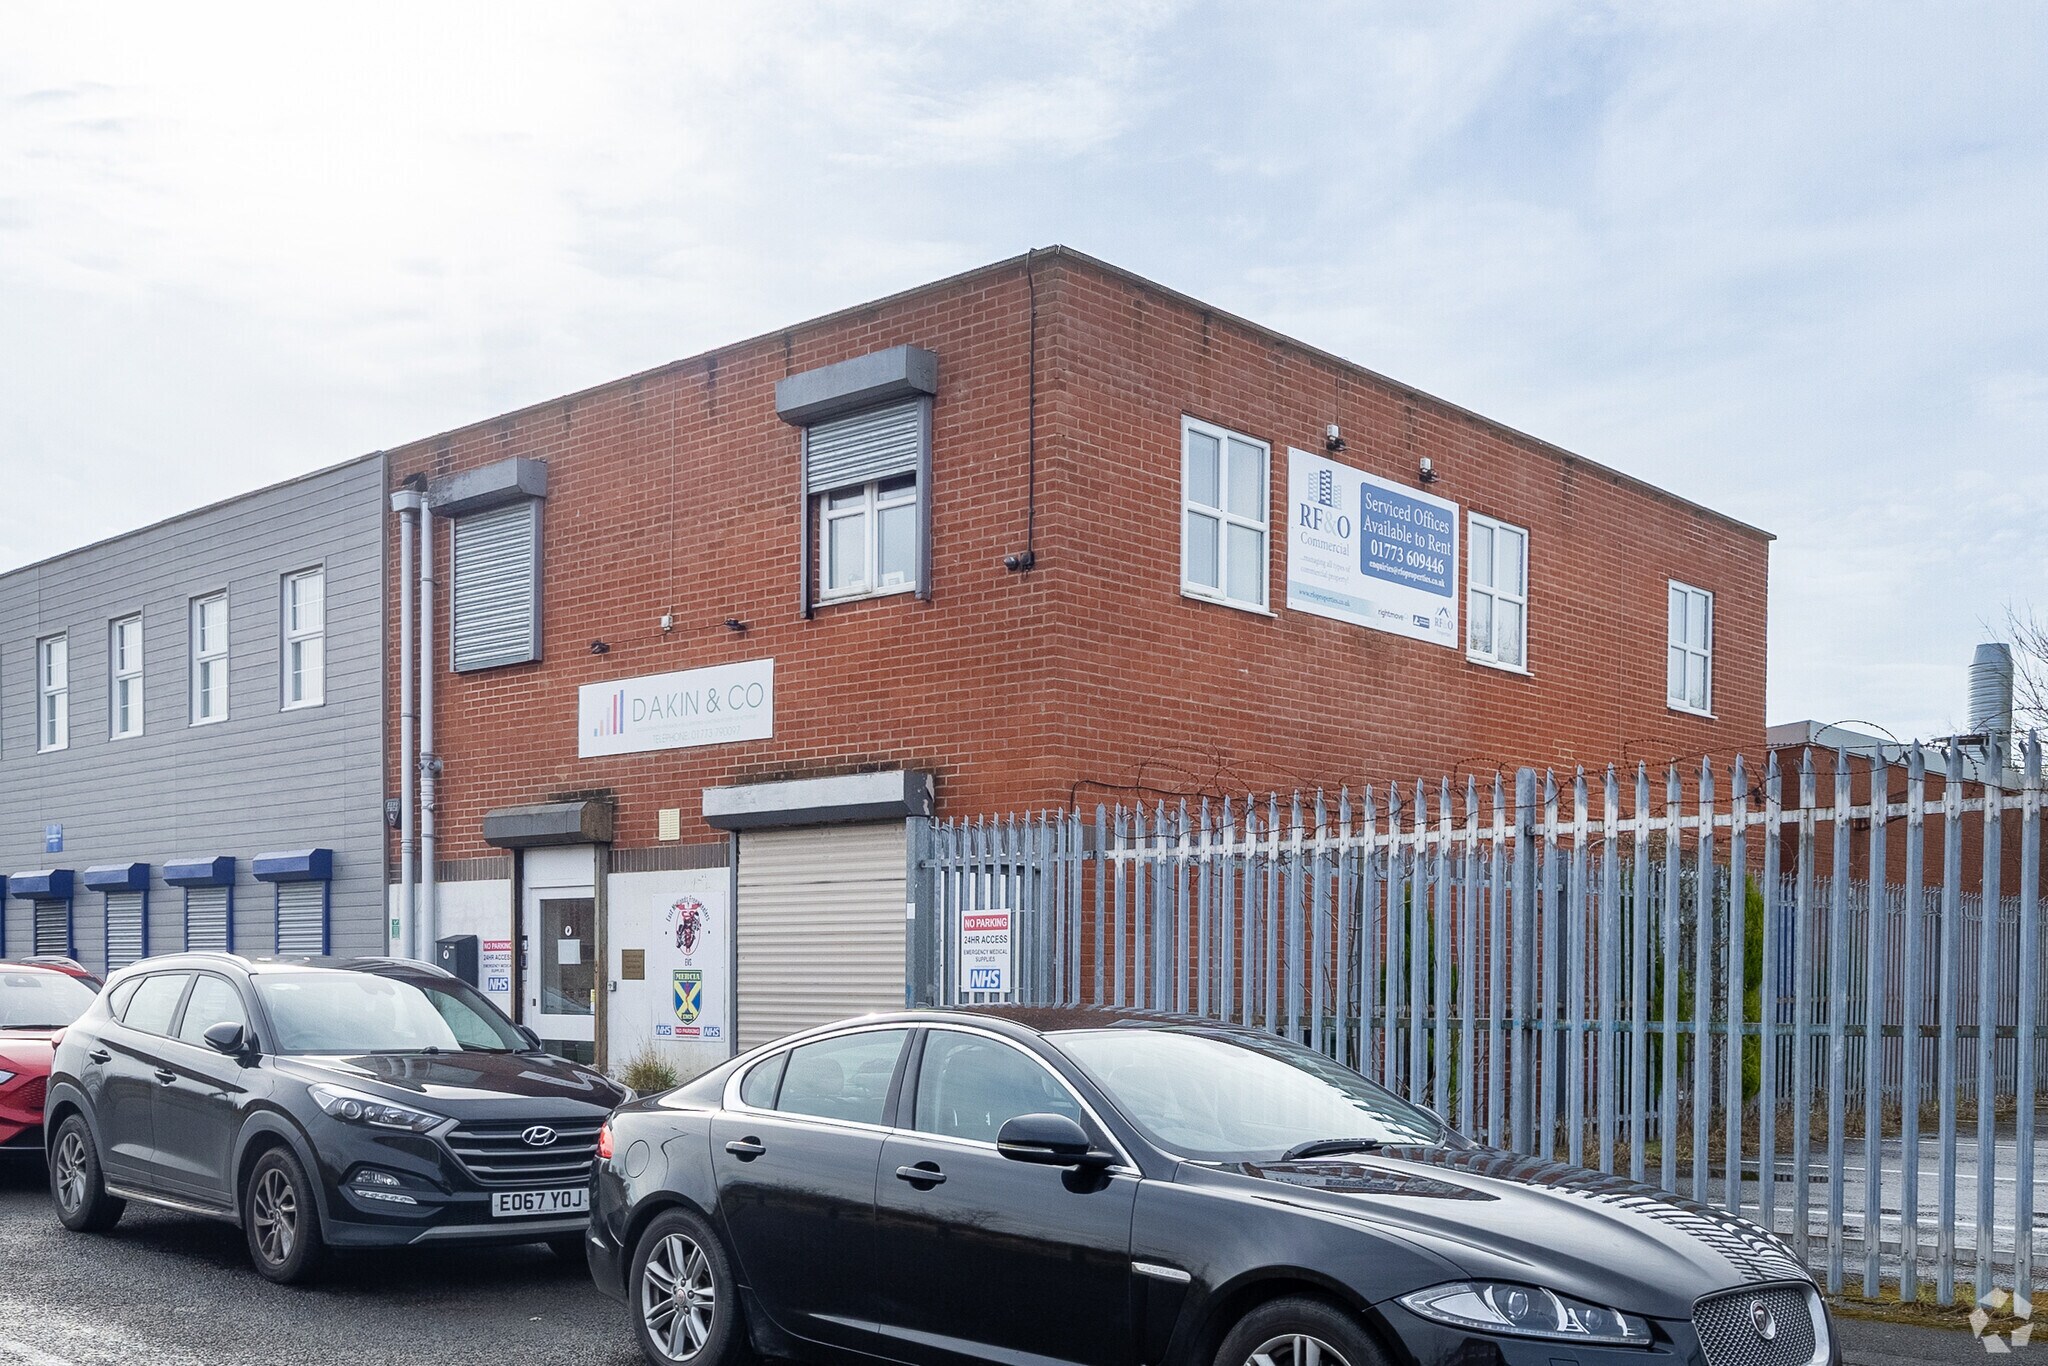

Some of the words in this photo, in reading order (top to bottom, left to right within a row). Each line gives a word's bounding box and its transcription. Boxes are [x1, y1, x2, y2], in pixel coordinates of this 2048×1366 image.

[1300, 503, 1350, 540] RF&O
[1366, 492, 1410, 522] Serviced
[1414, 508, 1449, 534] Offices
[1300, 532, 1350, 556] Commercial
[1363, 515, 1412, 544] Available
[1415, 532, 1425, 548] to
[1428, 534, 1451, 556] Rent
[1371, 540, 1404, 563] 01773
[1406, 550, 1444, 574] 609446
[1378, 609, 1404, 621] rightmove
[632, 690, 699, 722] DAKIN
[706, 688, 720, 713] &
[728, 682, 764, 710] CO
[965, 918, 975, 928] NO
[976, 917, 1007, 927] PARKING
[964, 936, 980, 944] 24HR
[981, 935, 1007, 944] ACCESS
[489, 978, 508, 990] NHS
[971, 970, 1000, 988] NHS
[656, 1025, 671, 1035] NHS
[704, 1027, 720, 1036] NHS
[551, 1190, 582, 1208] YOJ
